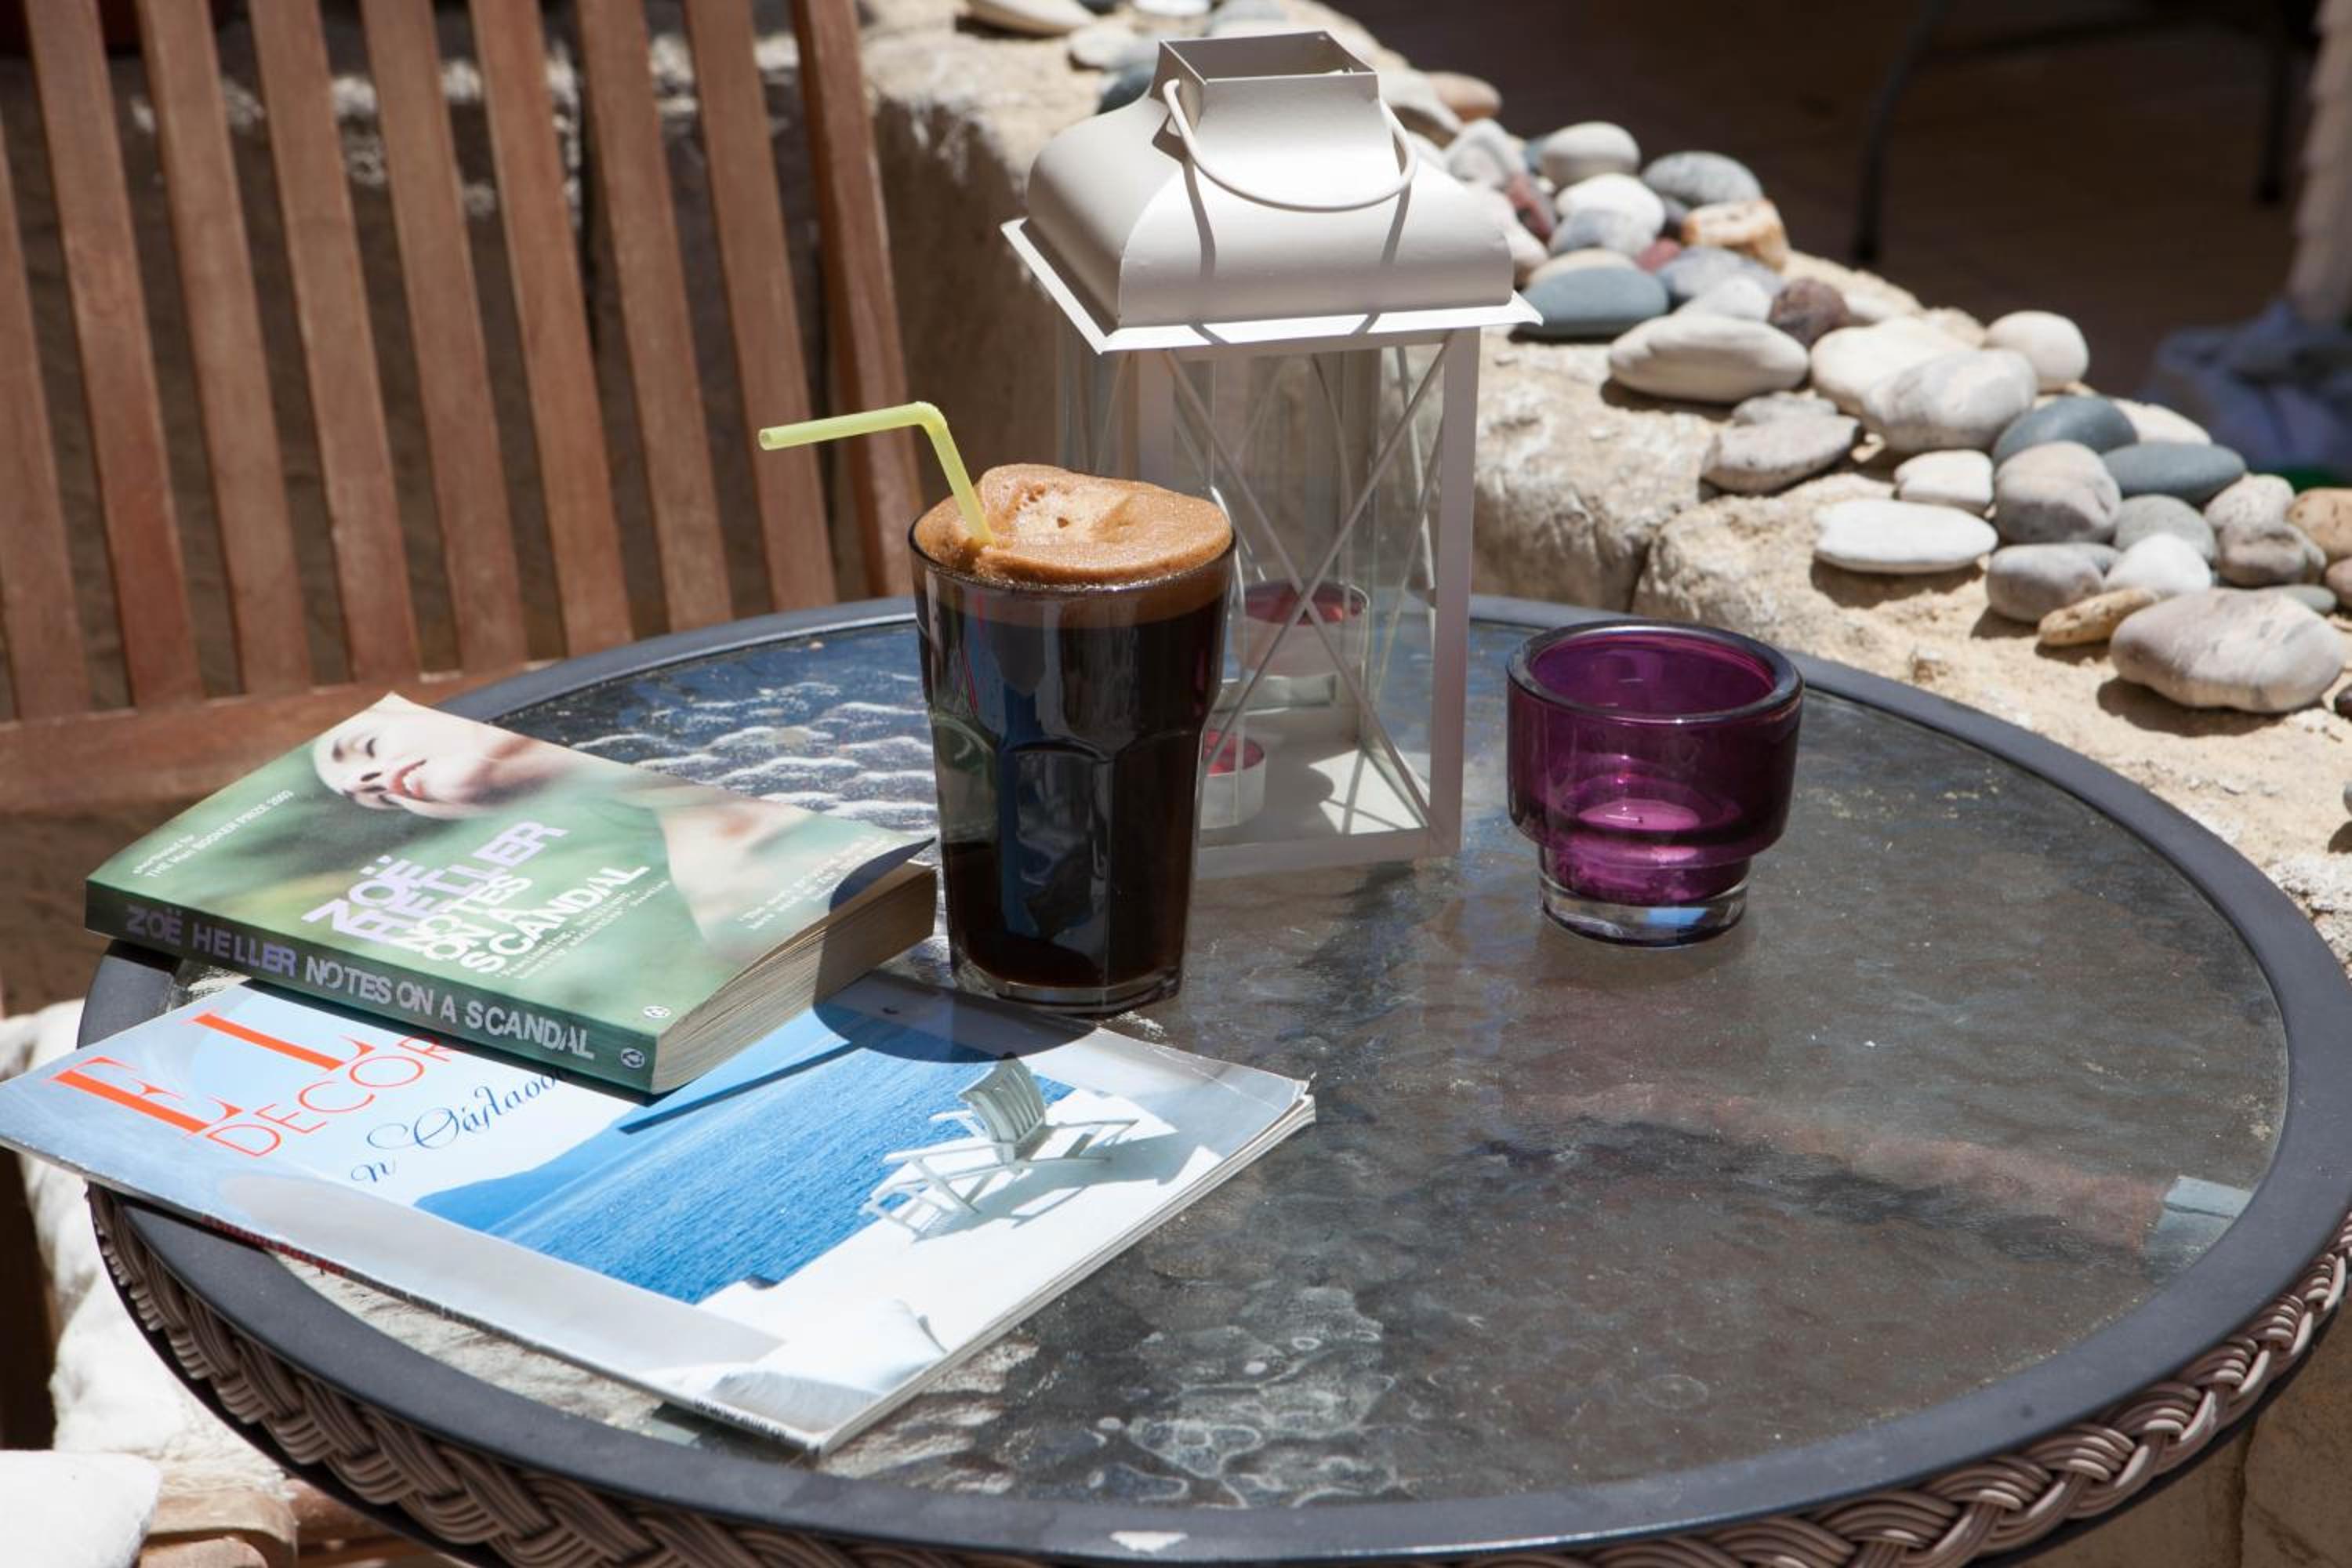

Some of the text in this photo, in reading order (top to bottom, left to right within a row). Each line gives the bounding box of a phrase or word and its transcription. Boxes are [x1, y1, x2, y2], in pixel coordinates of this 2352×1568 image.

[144, 862, 168, 877] THE
[301, 855, 437, 931] ZOË
[336, 819, 569, 944] HELLER
[389, 874, 534, 952] NOTES
[421, 922, 499, 961] ON
[459, 866, 651, 975] SCANDAL
[126, 906, 595, 1059] ZOË HELLER NOTES ON A SCANDAL
